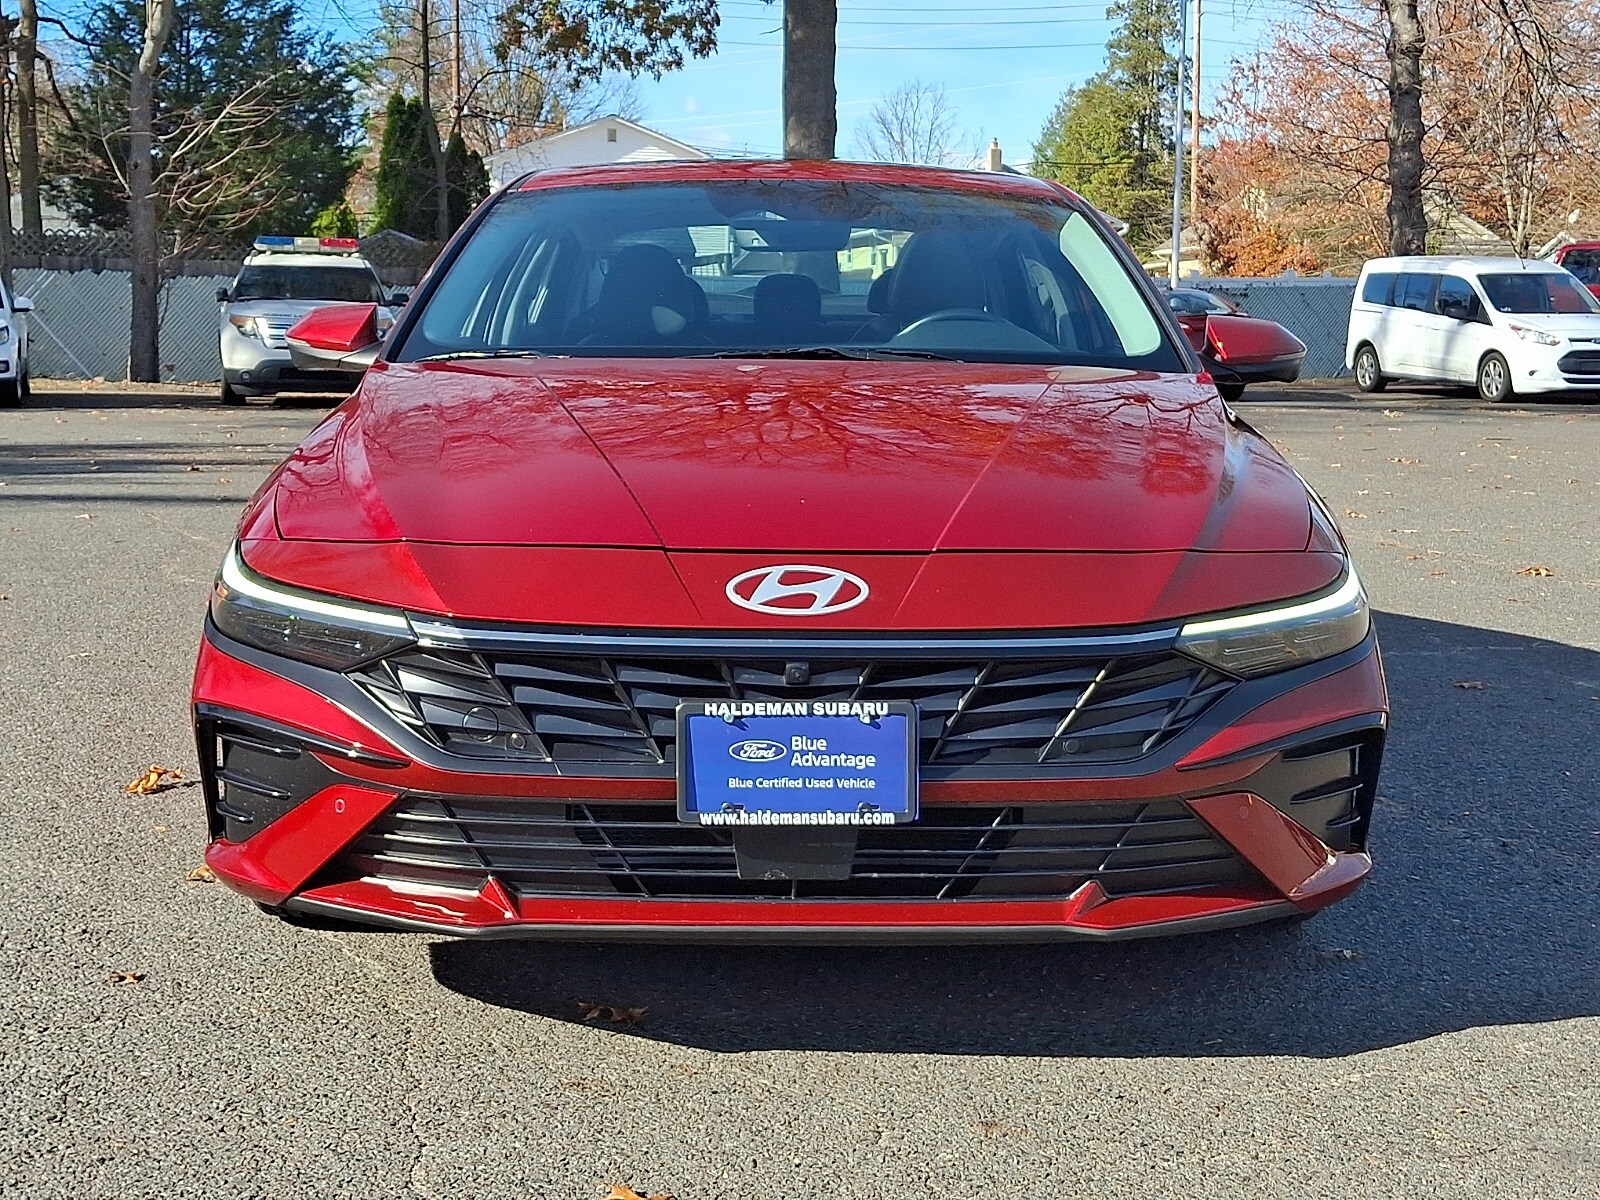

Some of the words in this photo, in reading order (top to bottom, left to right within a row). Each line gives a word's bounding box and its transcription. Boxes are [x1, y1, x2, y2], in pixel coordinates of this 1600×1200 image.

[704, 702, 808, 716] HALDEMAN
[812, 702, 889, 716] SUBARU
[739, 743, 777, 758] Ford
[791, 735, 827, 751] Blue
[790, 751, 876, 770] Advantage
[728, 777, 753, 789] Blue
[755, 777, 803, 789] Certified
[805, 777, 834, 789] Used
[836, 777, 876, 789] Vehicle
[699, 809, 896, 826] www.haldemansubaru.com
